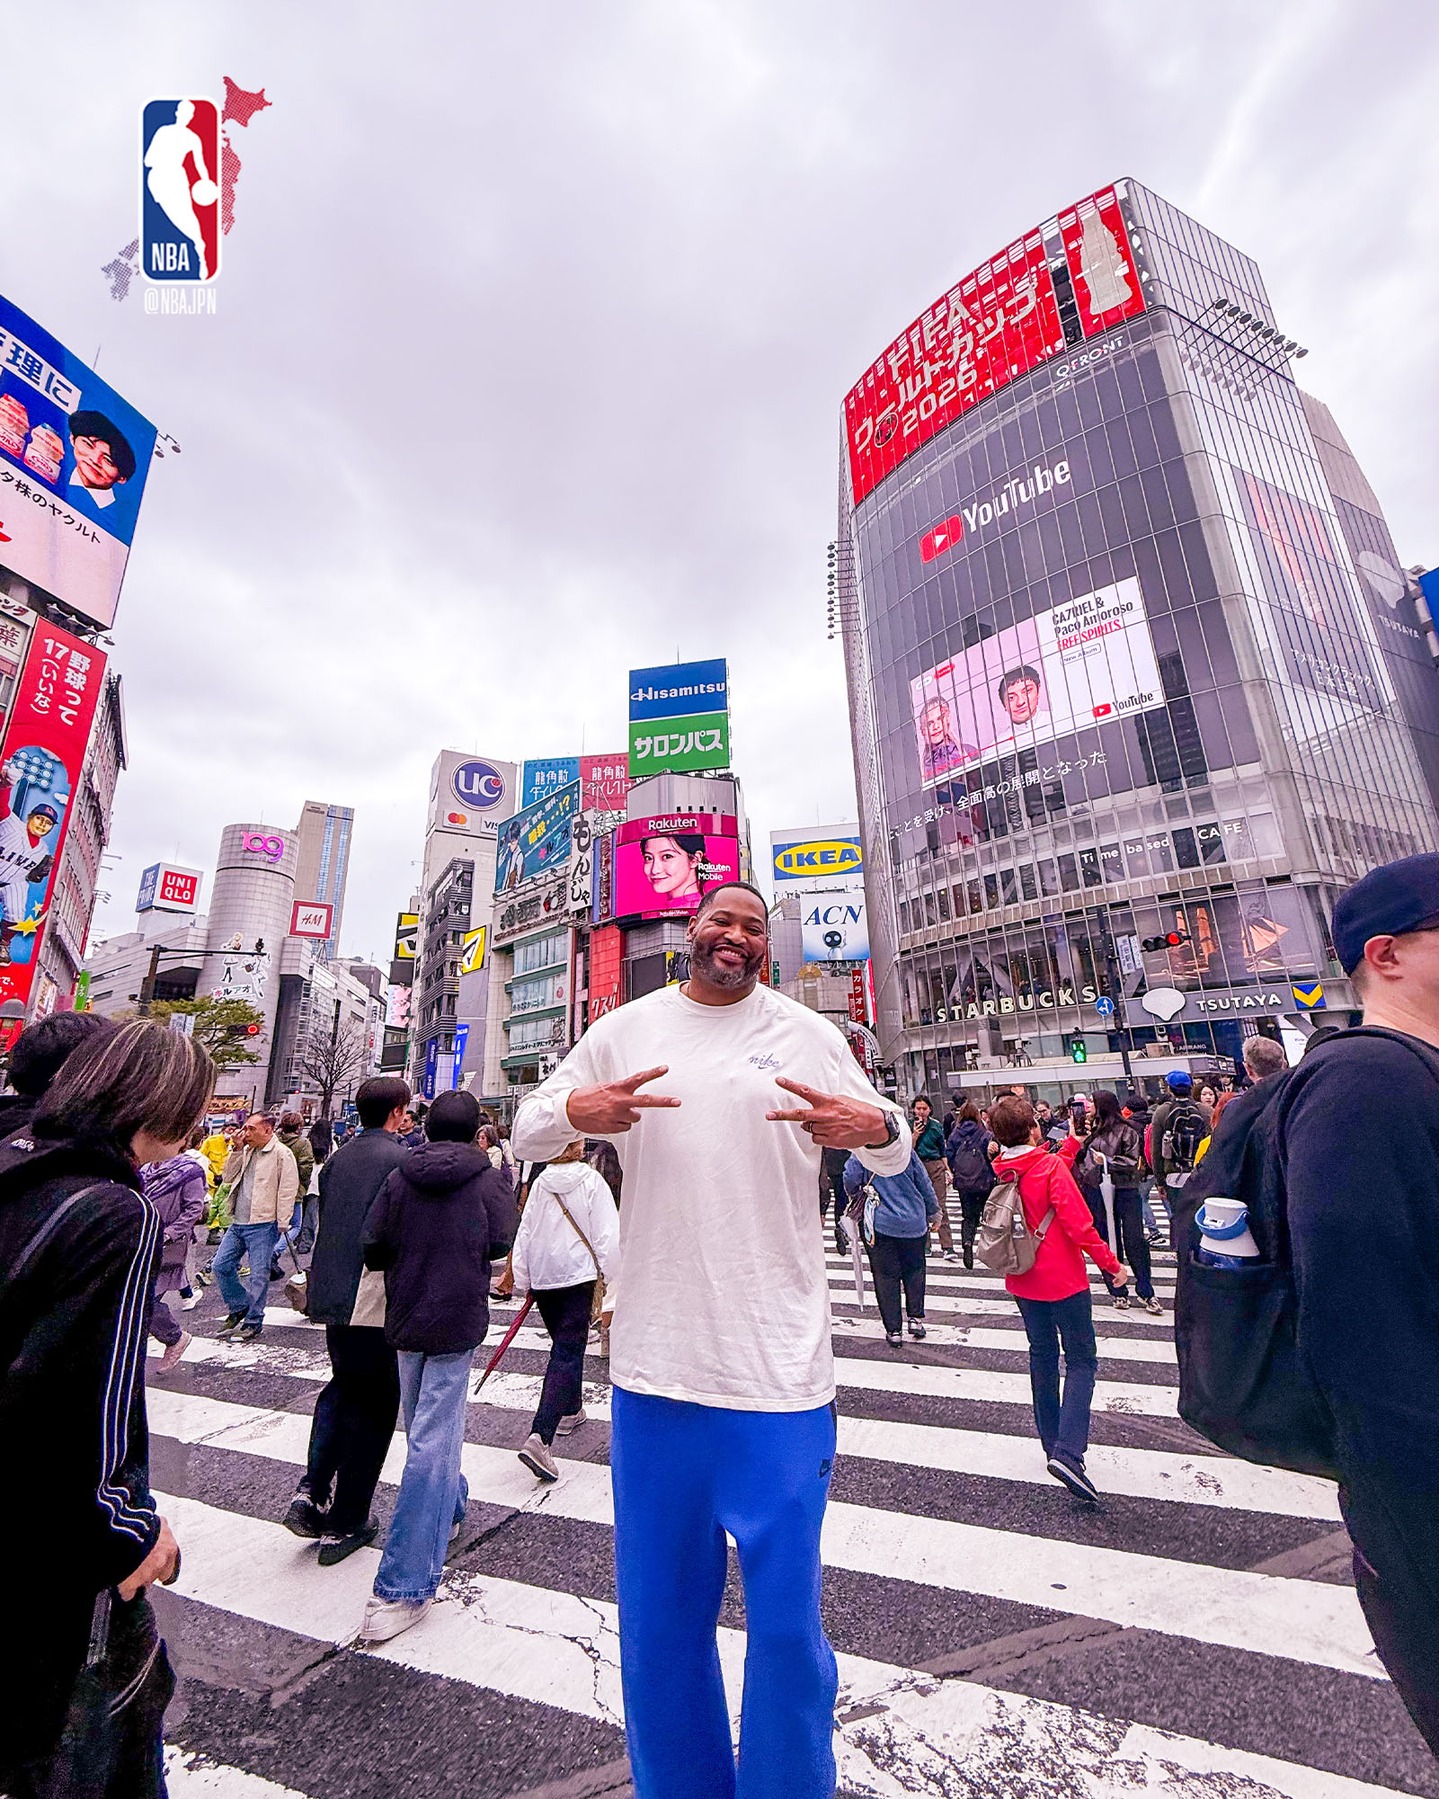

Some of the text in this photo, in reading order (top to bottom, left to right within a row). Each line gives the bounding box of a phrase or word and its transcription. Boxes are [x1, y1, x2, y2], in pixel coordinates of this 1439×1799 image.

[888, 299, 971, 383] FIFA
[0, 333, 73, 407] 理に
[1056, 336, 1124, 378] QFRONT
[902, 367, 978, 438] 2026
[1, 471, 101, 544] タ株のヤクルト
[963, 460, 1071, 533] YouTube
[1096, 596, 1105, 609] &
[1054, 601, 1133, 638] Paco Amoroso
[1081, 619, 1121, 643] SPIRITS
[58, 649, 91, 726] 野球って
[630, 682, 725, 701] Hisamitsu
[1112, 691, 1154, 711] YouTube
[635, 728, 723, 759] サロンパス
[591, 765, 626, 780] 龍角散
[648, 817, 698, 832] Rakuten
[241, 831, 285, 863] 109
[1081, 822, 1243, 864] Time based CAFE
[570, 813, 591, 905] もんじゃ
[698, 863, 731, 872] Rakuten
[783, 848, 860, 868] IKEA
[166, 875, 191, 889] UNI
[698, 873, 723, 881] Mobile
[164, 887, 191, 900] QLO
[803, 905, 864, 925] ACN
[853, 975, 864, 1025] カラオケ
[937, 985, 1098, 1023] STARBUCKS
[1196, 993, 1282, 1012] TSUTAYA
[748, 1053, 780, 1068] nike
